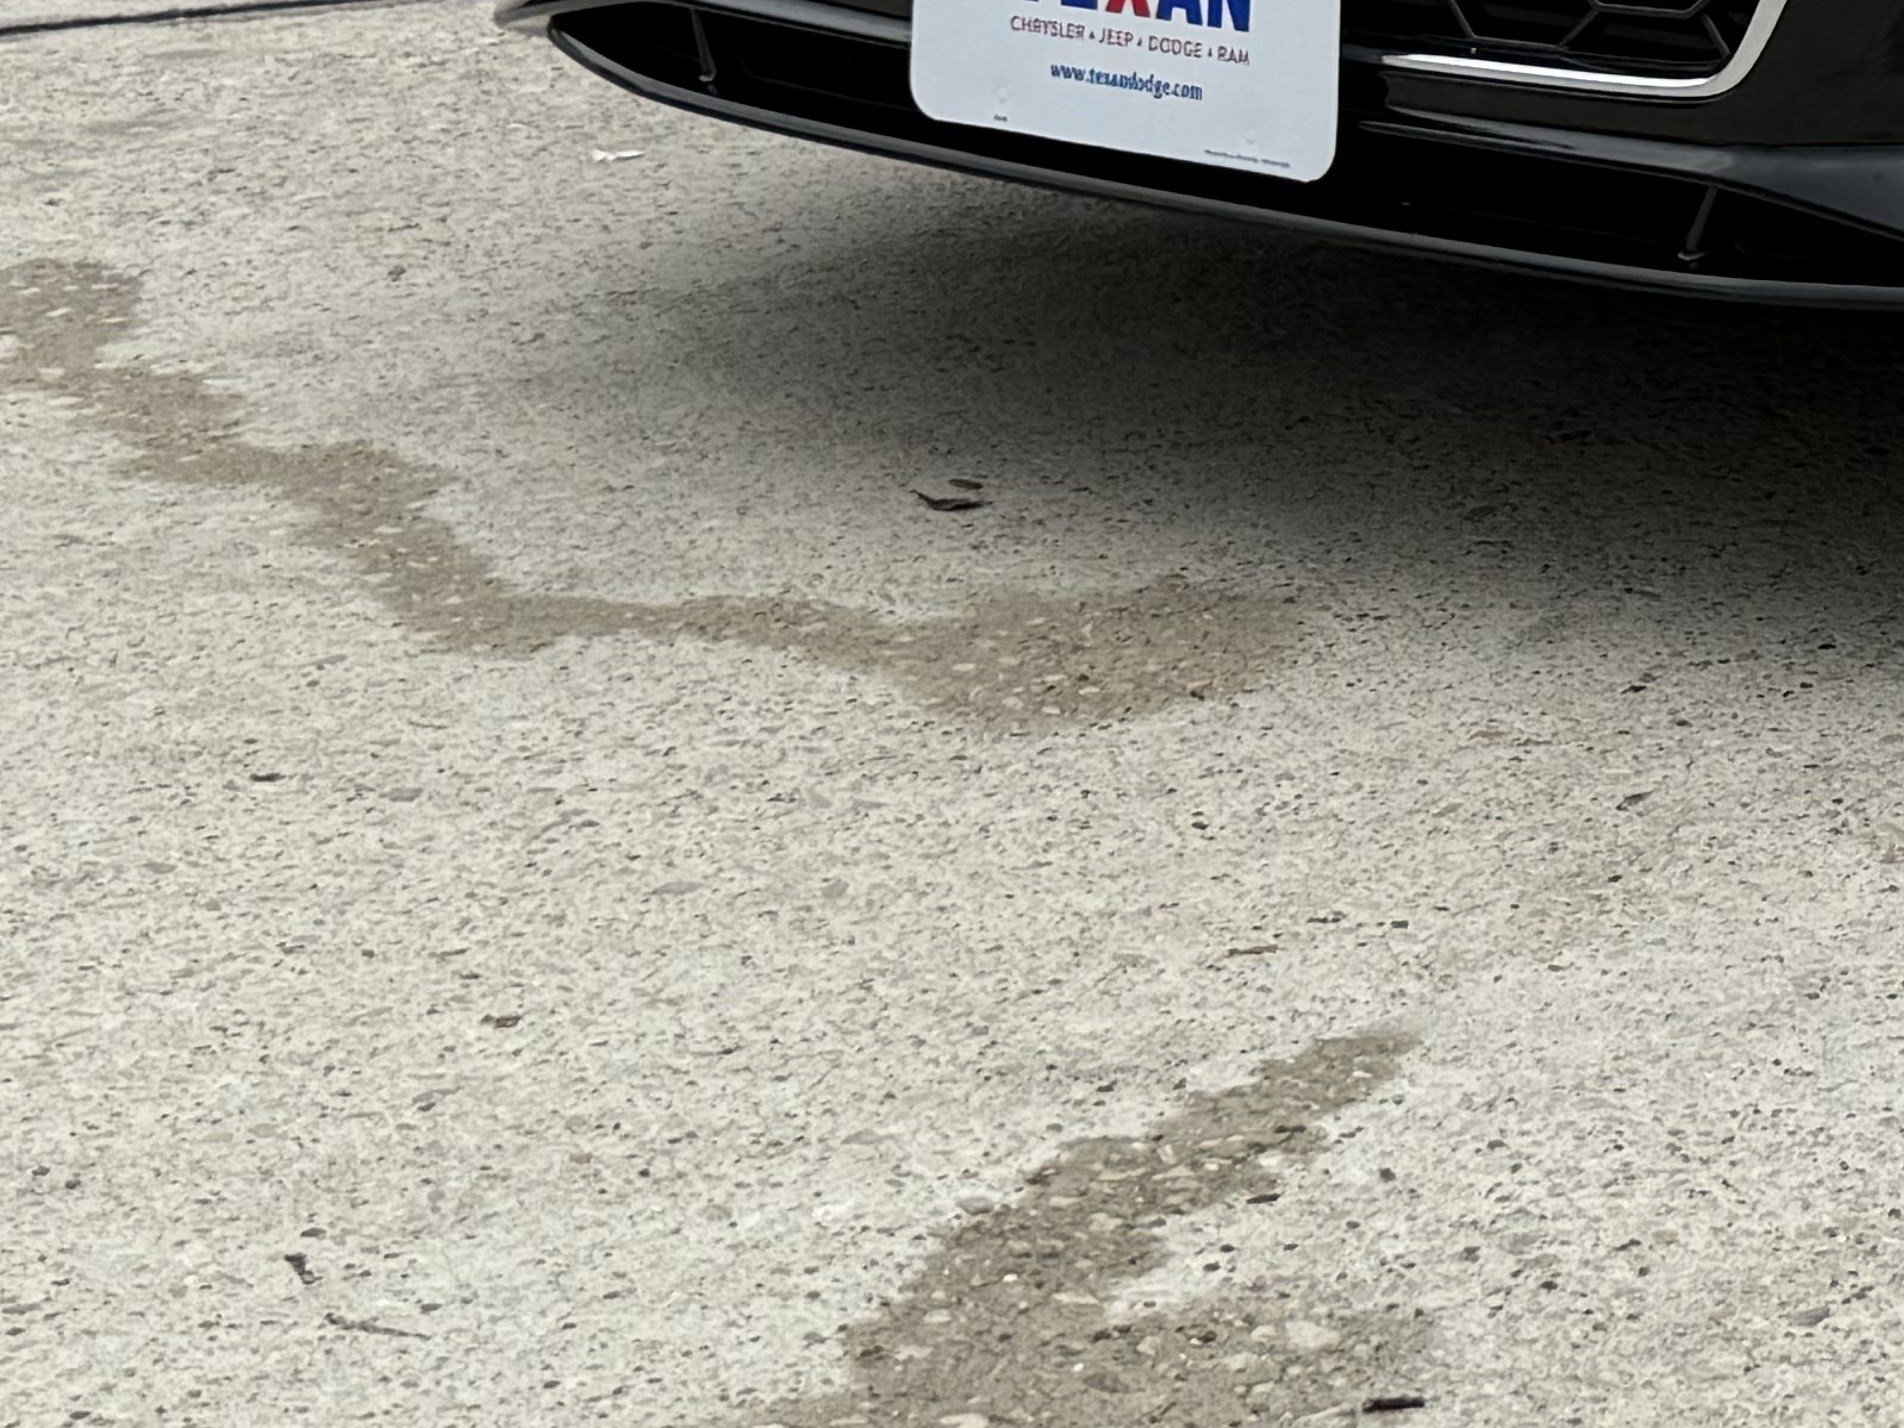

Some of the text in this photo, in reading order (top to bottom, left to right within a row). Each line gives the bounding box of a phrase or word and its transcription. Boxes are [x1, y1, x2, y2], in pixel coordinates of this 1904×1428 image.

[1010, 15, 1250, 66] CHRYSLER JEEP DODGE RAM
[1050, 63, 1204, 101] www.texandodge.com
